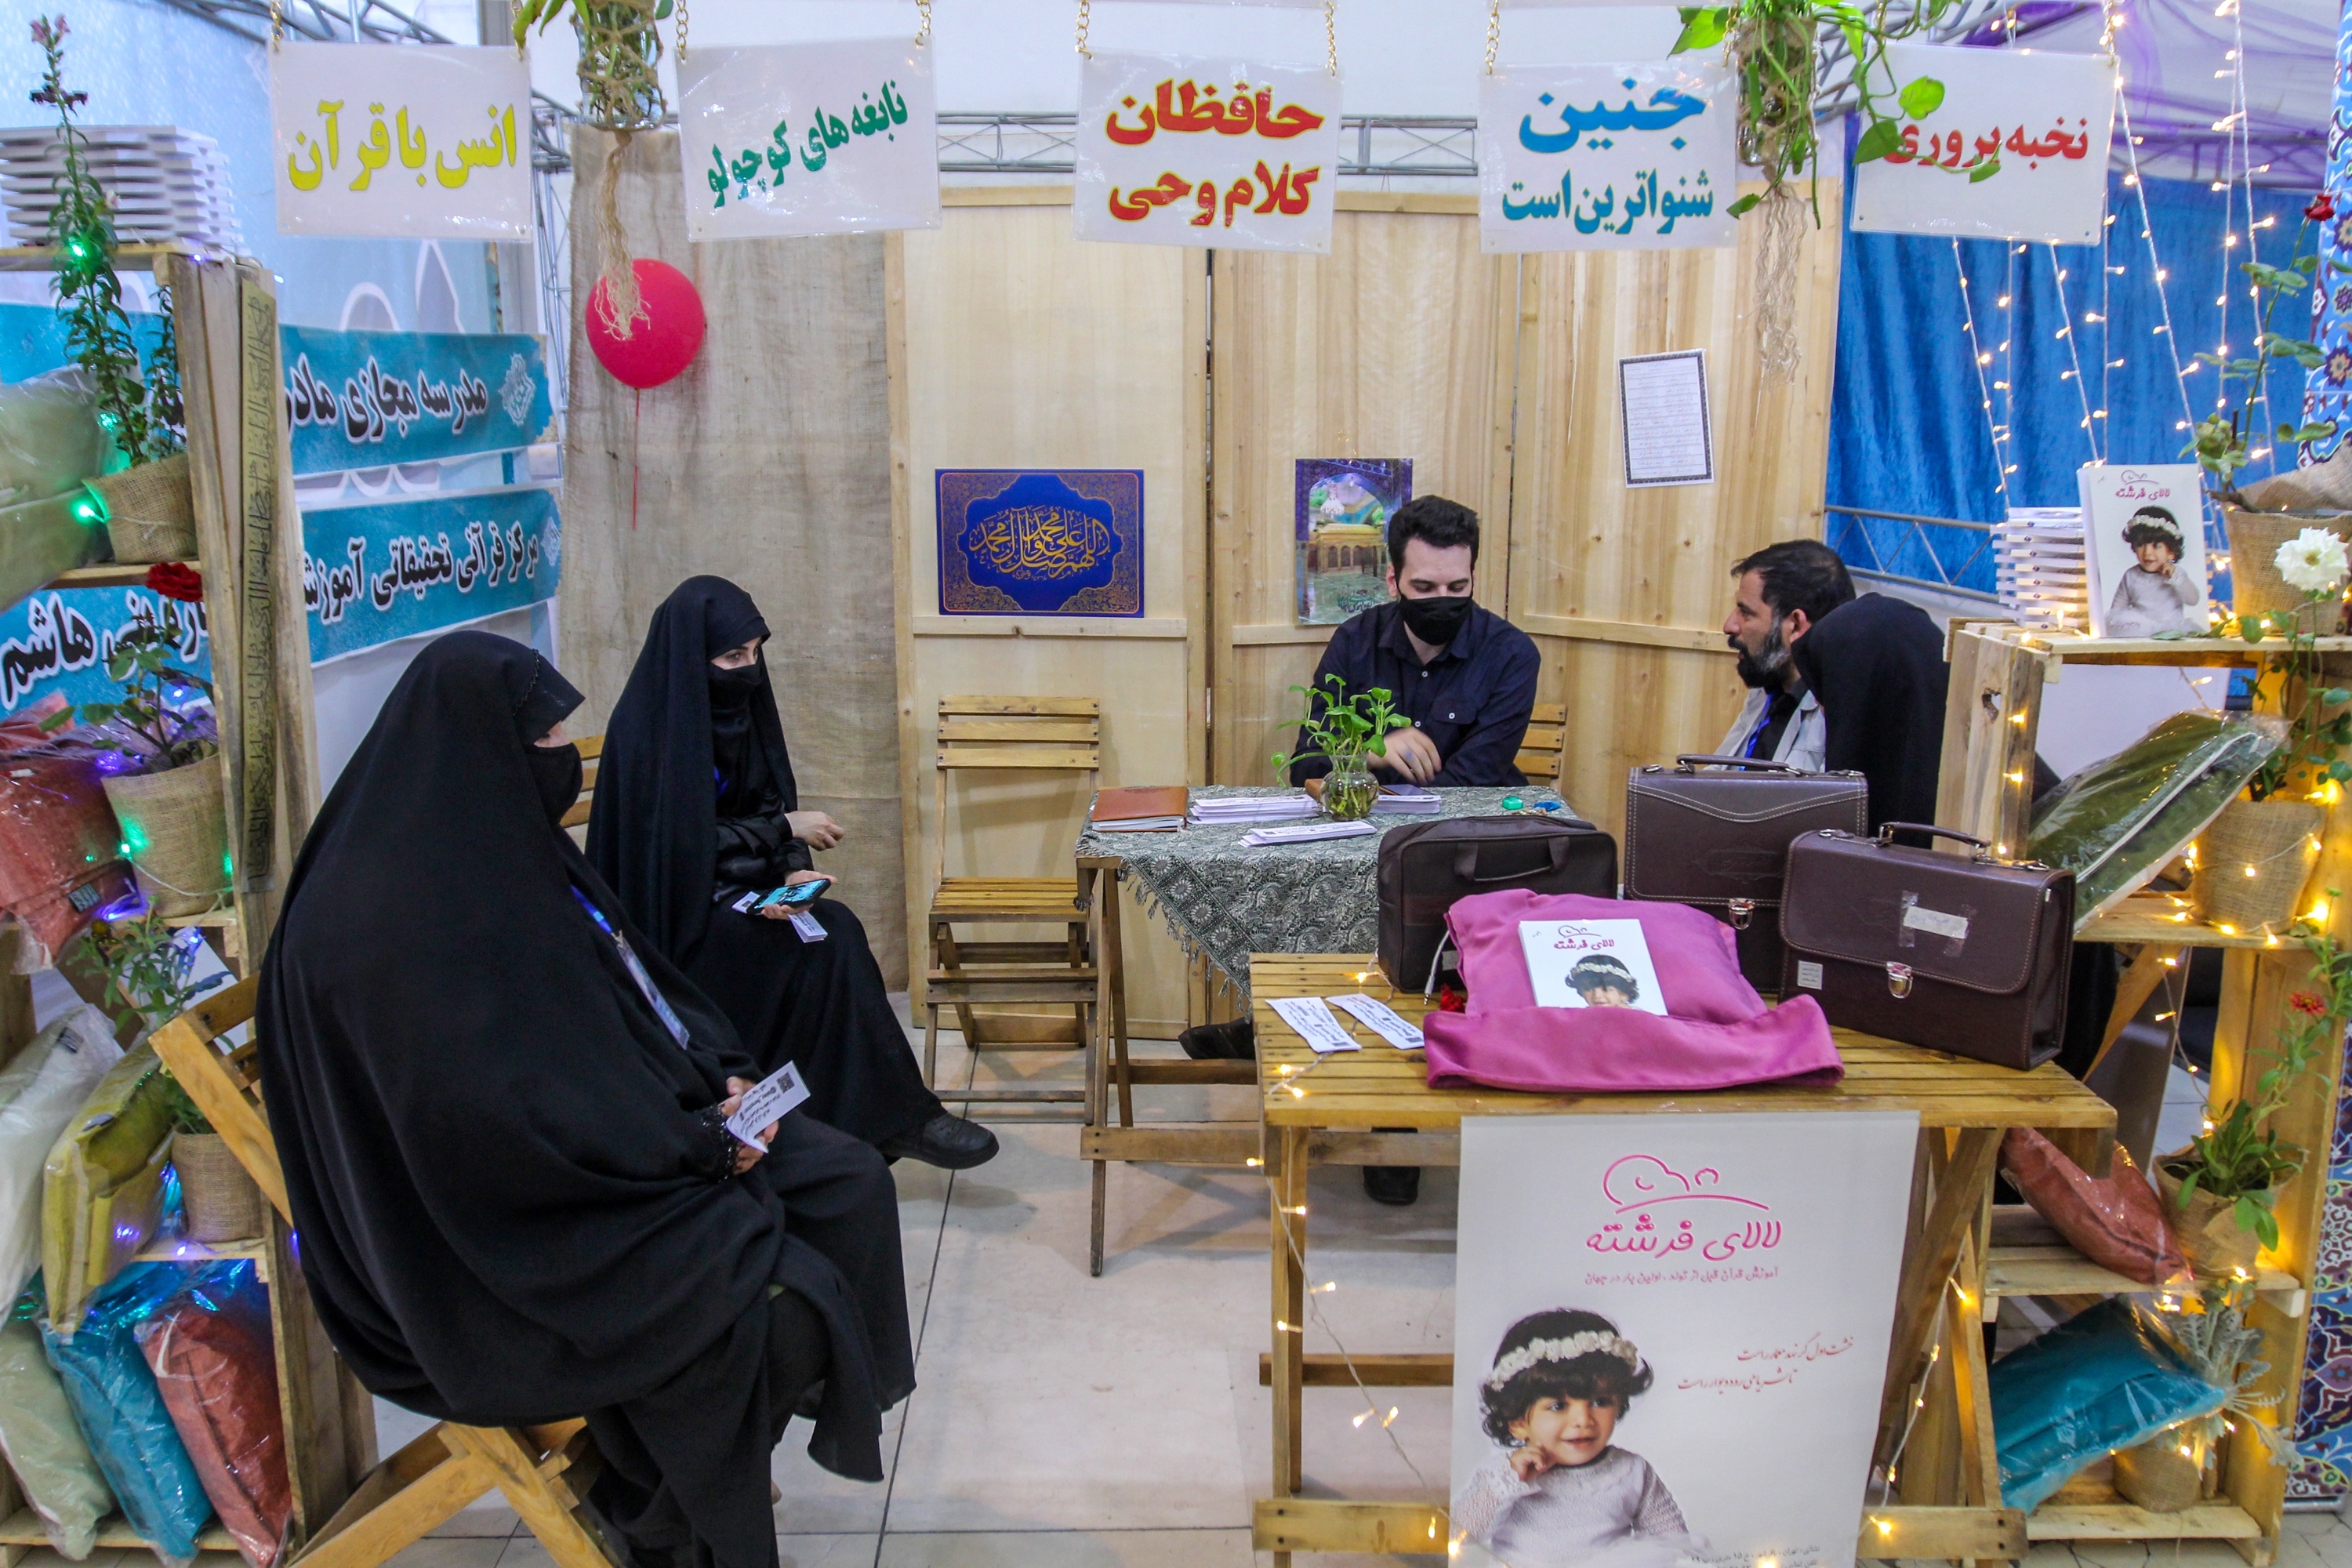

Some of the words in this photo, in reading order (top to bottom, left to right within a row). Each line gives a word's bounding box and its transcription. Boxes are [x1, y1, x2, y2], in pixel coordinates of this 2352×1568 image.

[800, 105, 849, 172] های
[851, 79, 908, 142] نابغه
[1105, 78, 1325, 146] حافظان
[1519, 77, 1709, 153] جنین
[289, 99, 390, 191] قرآن
[395, 104, 426, 187] با
[436, 103, 517, 188] انس
[707, 119, 791, 209] کوچولو
[1225, 159, 1321, 227] کلام
[1502, 167, 1571, 220] است
[339, 354, 421, 444] مجازی
[417, 368, 488, 434] مدرسه
[371, 532, 453, 611] تحقیقاتی
[456, 520, 506, 593] قرآنی
[506, 520, 539, 582] مرکز
[2, 593, 96, 707] هاشم
[1586, 1214, 1695, 1259] فرشته
[1690, 1269, 1699, 1281] از
[1700, 1269, 1719, 1283] قبل
[1721, 1268, 1744, 1282] قرآن
[1746, 1265, 1779, 1281] آموزش
